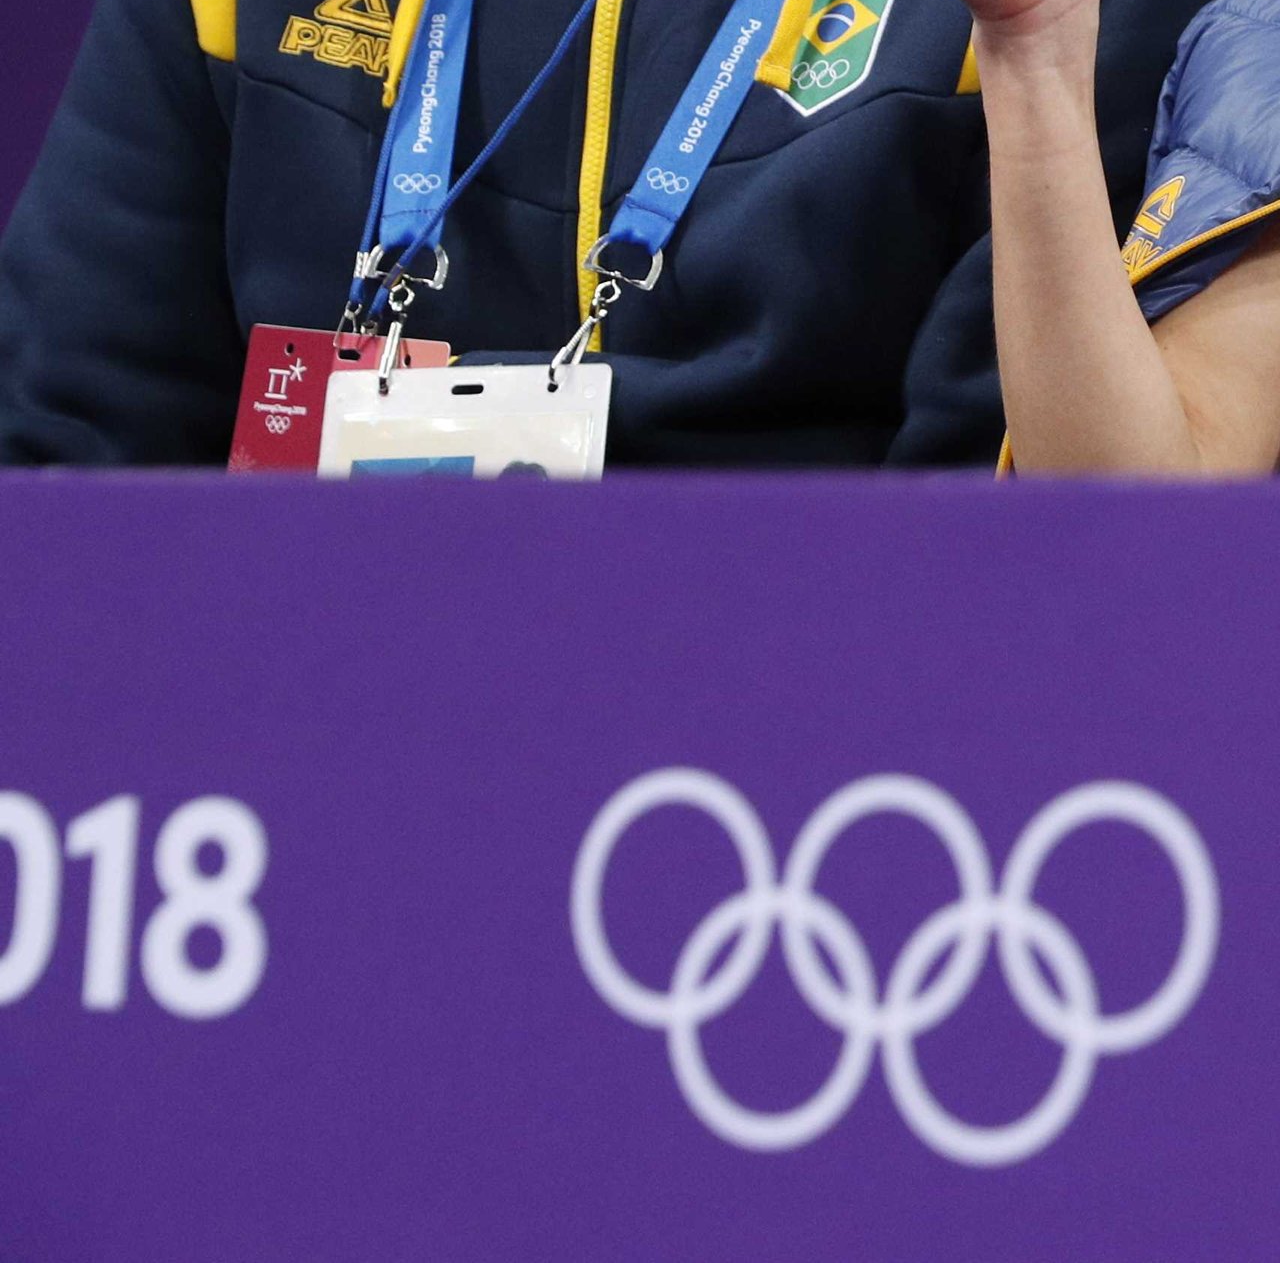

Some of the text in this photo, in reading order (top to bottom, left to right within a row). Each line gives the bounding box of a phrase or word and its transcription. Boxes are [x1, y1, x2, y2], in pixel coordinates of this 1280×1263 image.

[412, 13, 447, 153] PyeongChang 2018
[679, 18, 762, 154] PyeongChang 2018
